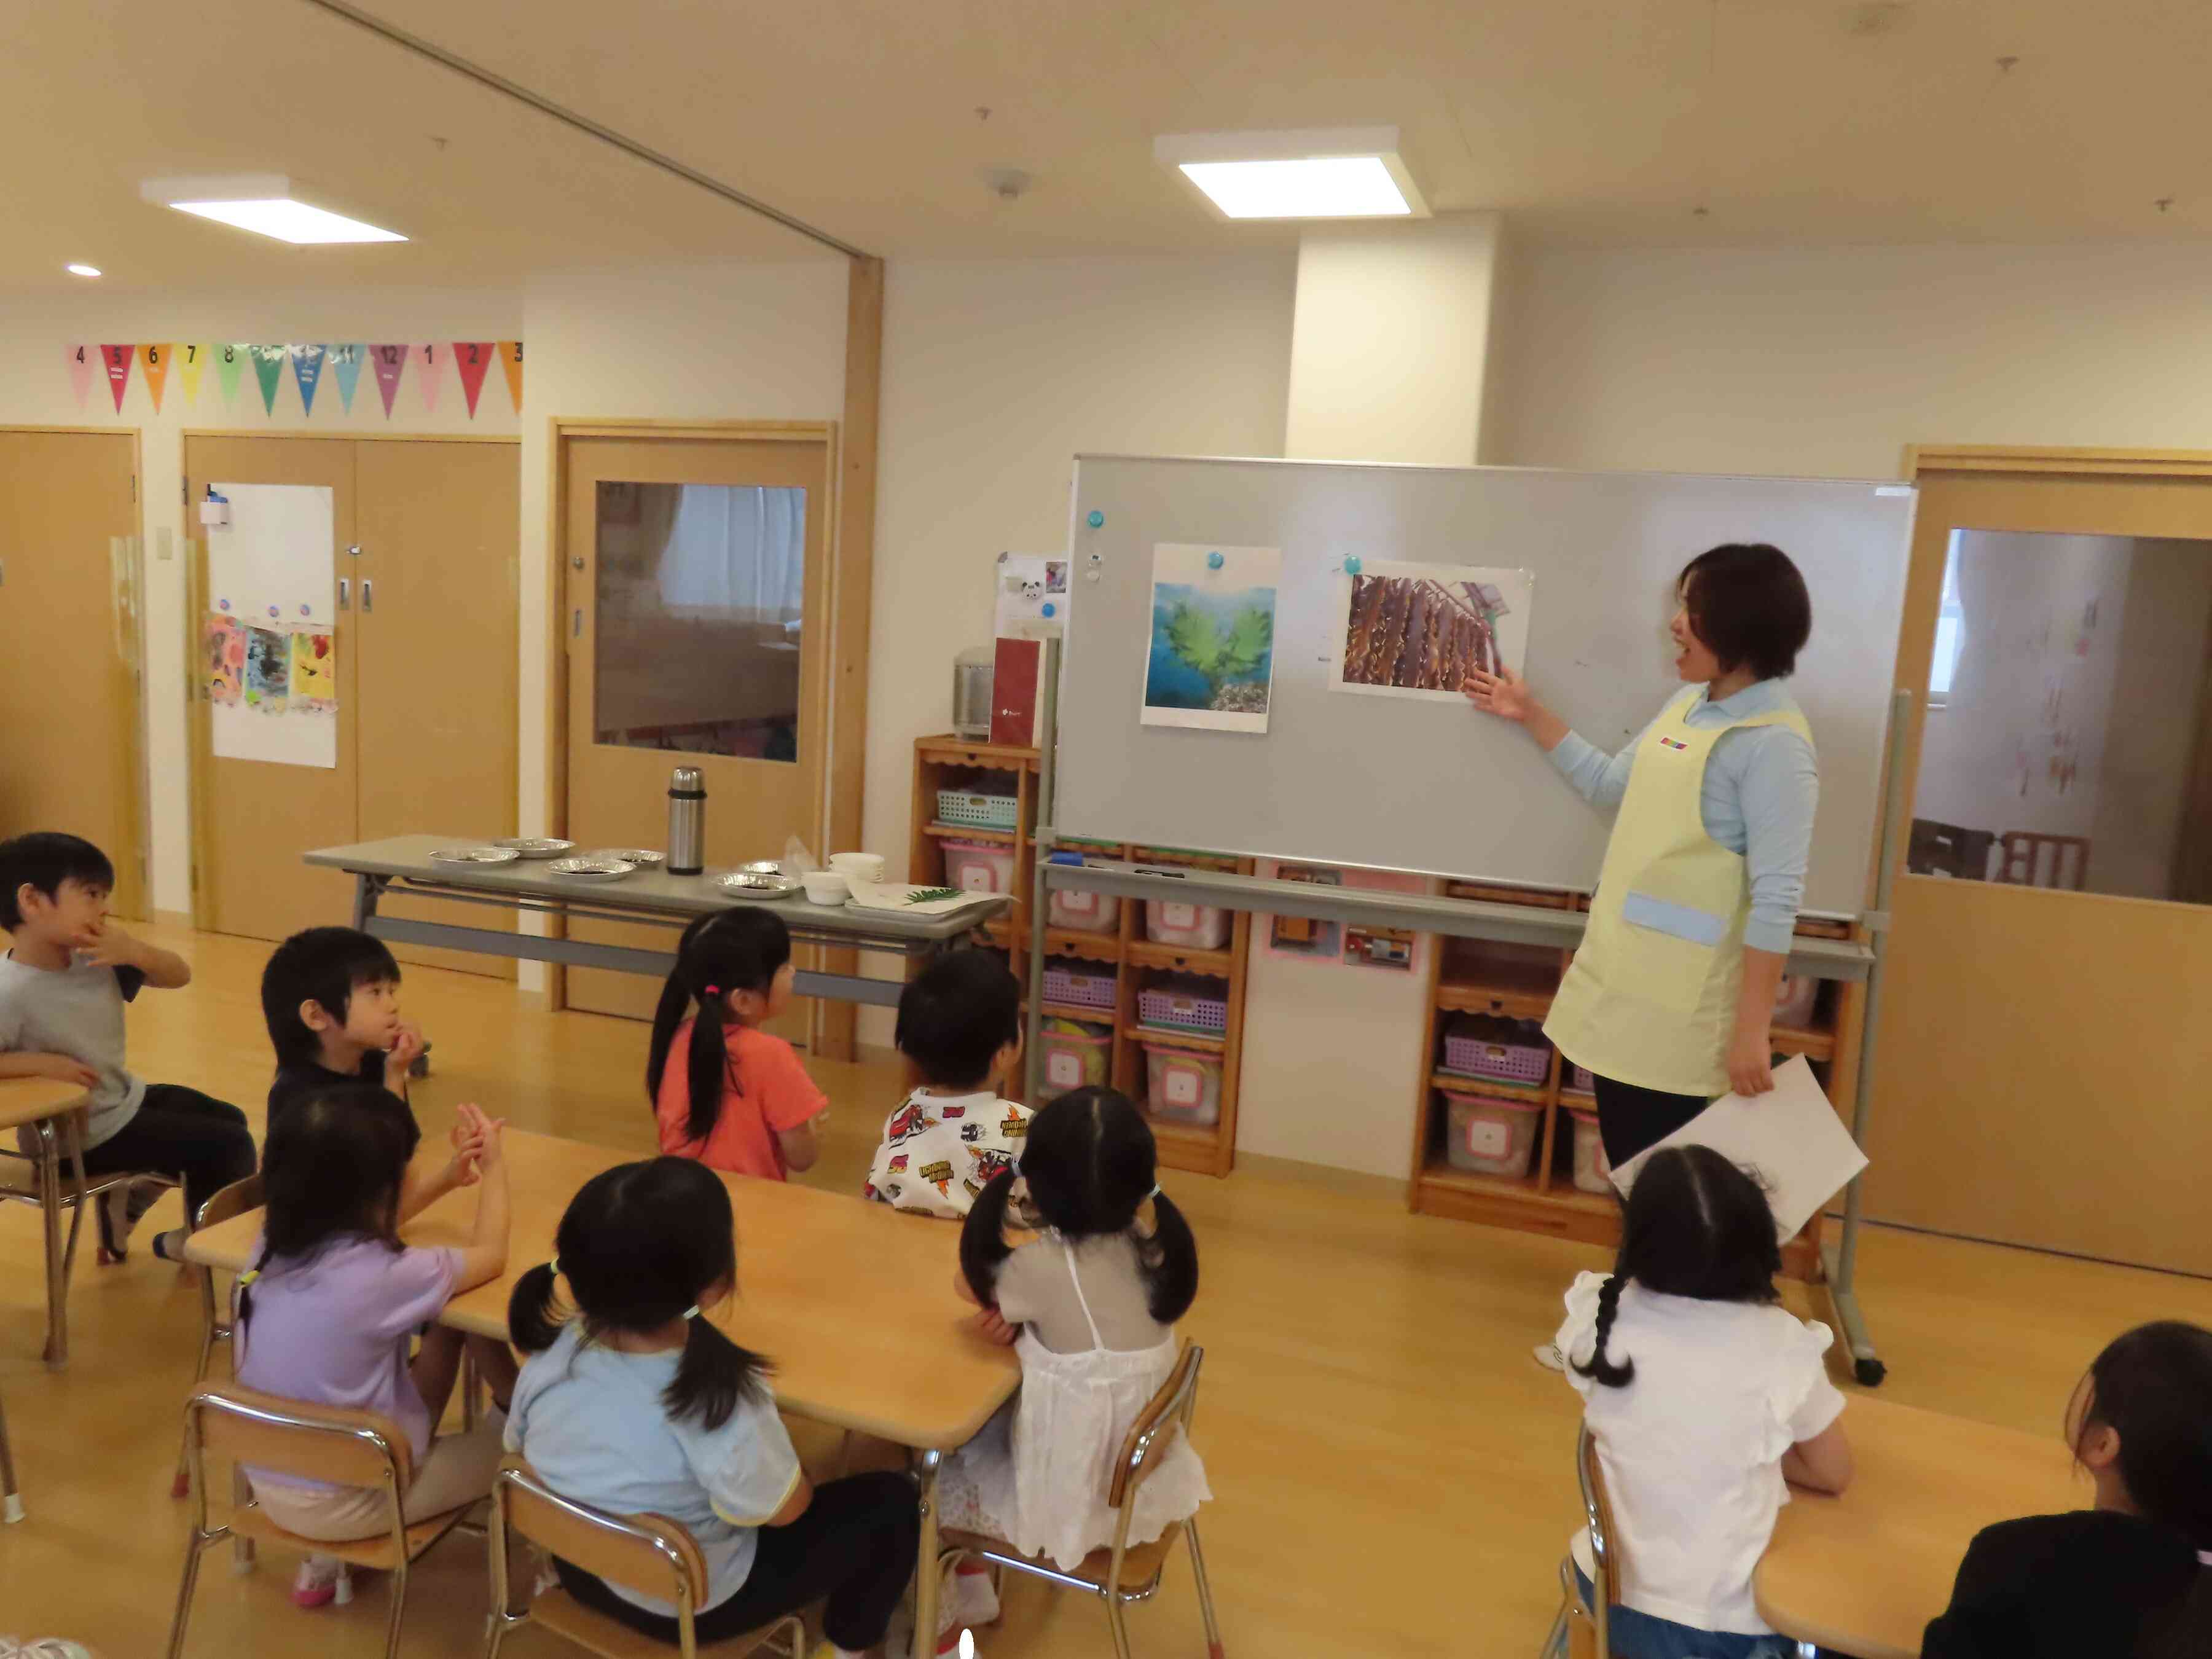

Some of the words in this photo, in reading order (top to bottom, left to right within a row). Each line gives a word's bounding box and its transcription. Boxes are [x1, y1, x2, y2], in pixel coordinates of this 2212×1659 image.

[77, 345, 85, 364] 4
[113, 346, 122, 364] 5
[149, 345, 158, 364] 6
[187, 345, 196, 364] 7
[225, 345, 233, 363] 8
[380, 345, 398, 364] 12
[425, 345, 433, 364] 1
[468, 343, 479, 364] 2
[514, 342, 523, 362] 3
